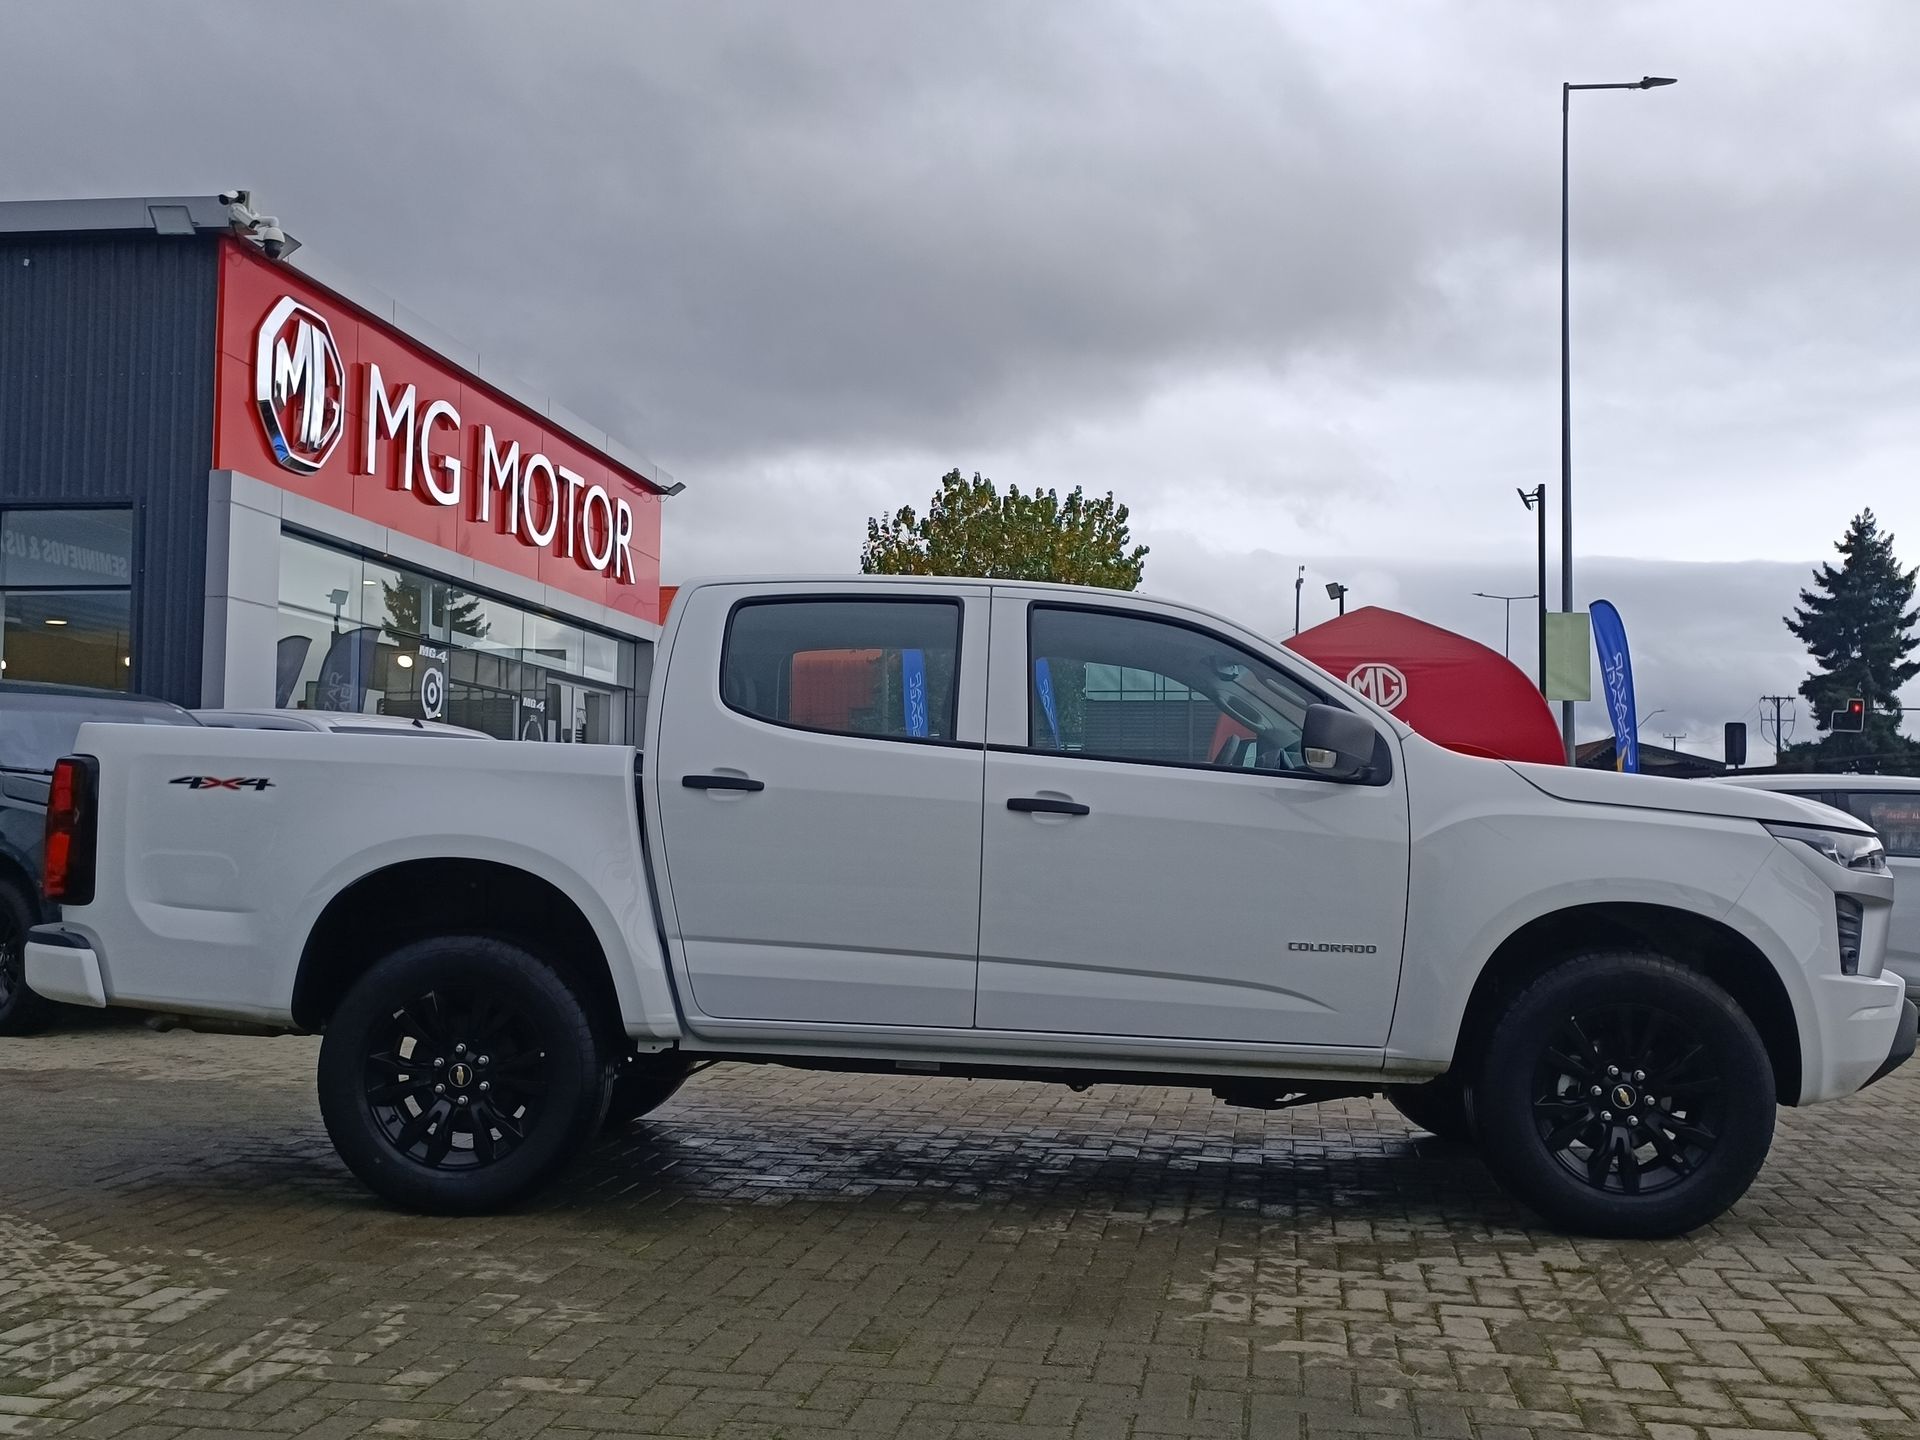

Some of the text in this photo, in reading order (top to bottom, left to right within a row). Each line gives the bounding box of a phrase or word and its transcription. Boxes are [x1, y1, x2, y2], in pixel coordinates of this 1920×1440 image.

[273, 317, 341, 453] MG
[362, 362, 637, 585] MG MOTOR
[1353, 667, 1400, 706] MG
[1288, 942, 1377, 954] COLORADO
